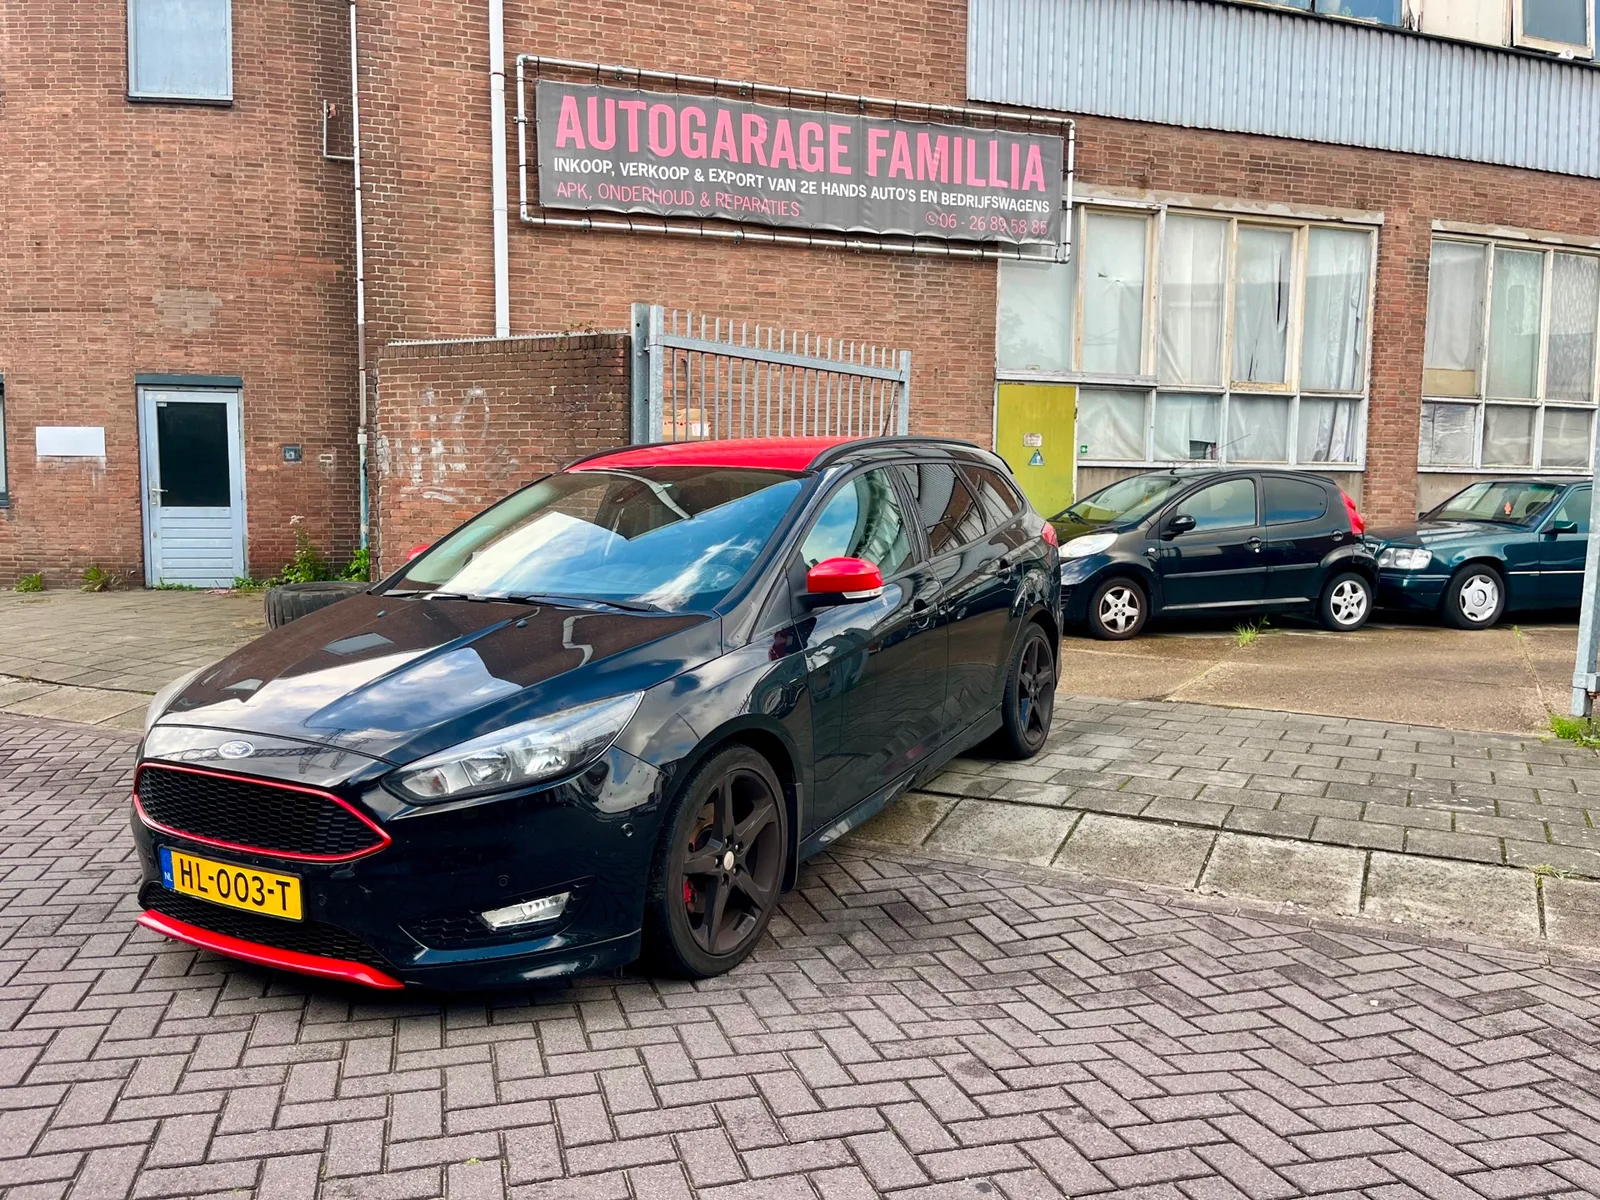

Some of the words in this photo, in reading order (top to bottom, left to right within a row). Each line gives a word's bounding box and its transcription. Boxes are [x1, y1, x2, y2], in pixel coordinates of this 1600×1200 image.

[555, 96, 852, 175] AUTOGARAGE
[867, 128, 1046, 192] FAMILLIA
[554, 157, 616, 176] INKOOP,
[619, 162, 690, 180] VERKOOP
[693, 168, 704, 182] &
[708, 168, 764, 188] EXPORT
[767, 177, 796, 192] VAN
[800, 180, 817, 194] 2E
[821, 182, 867, 198] HANDS
[920, 189, 938, 204] EN
[941, 193, 1050, 213] BEDRIJFSWAGENS
[556, 181, 592, 201] APK,
[597, 183, 695, 206] ONDERHOUD
[700, 192, 711, 207] &
[714, 191, 800, 217] REPARATIES
[939, 213, 957, 228] 06
[969, 216, 986, 231] 26
[989, 217, 1006, 231] 89
[1011, 219, 1027, 234] 58
[164, 872, 173, 882] NL
[179, 858, 291, 911] HL-003-T
